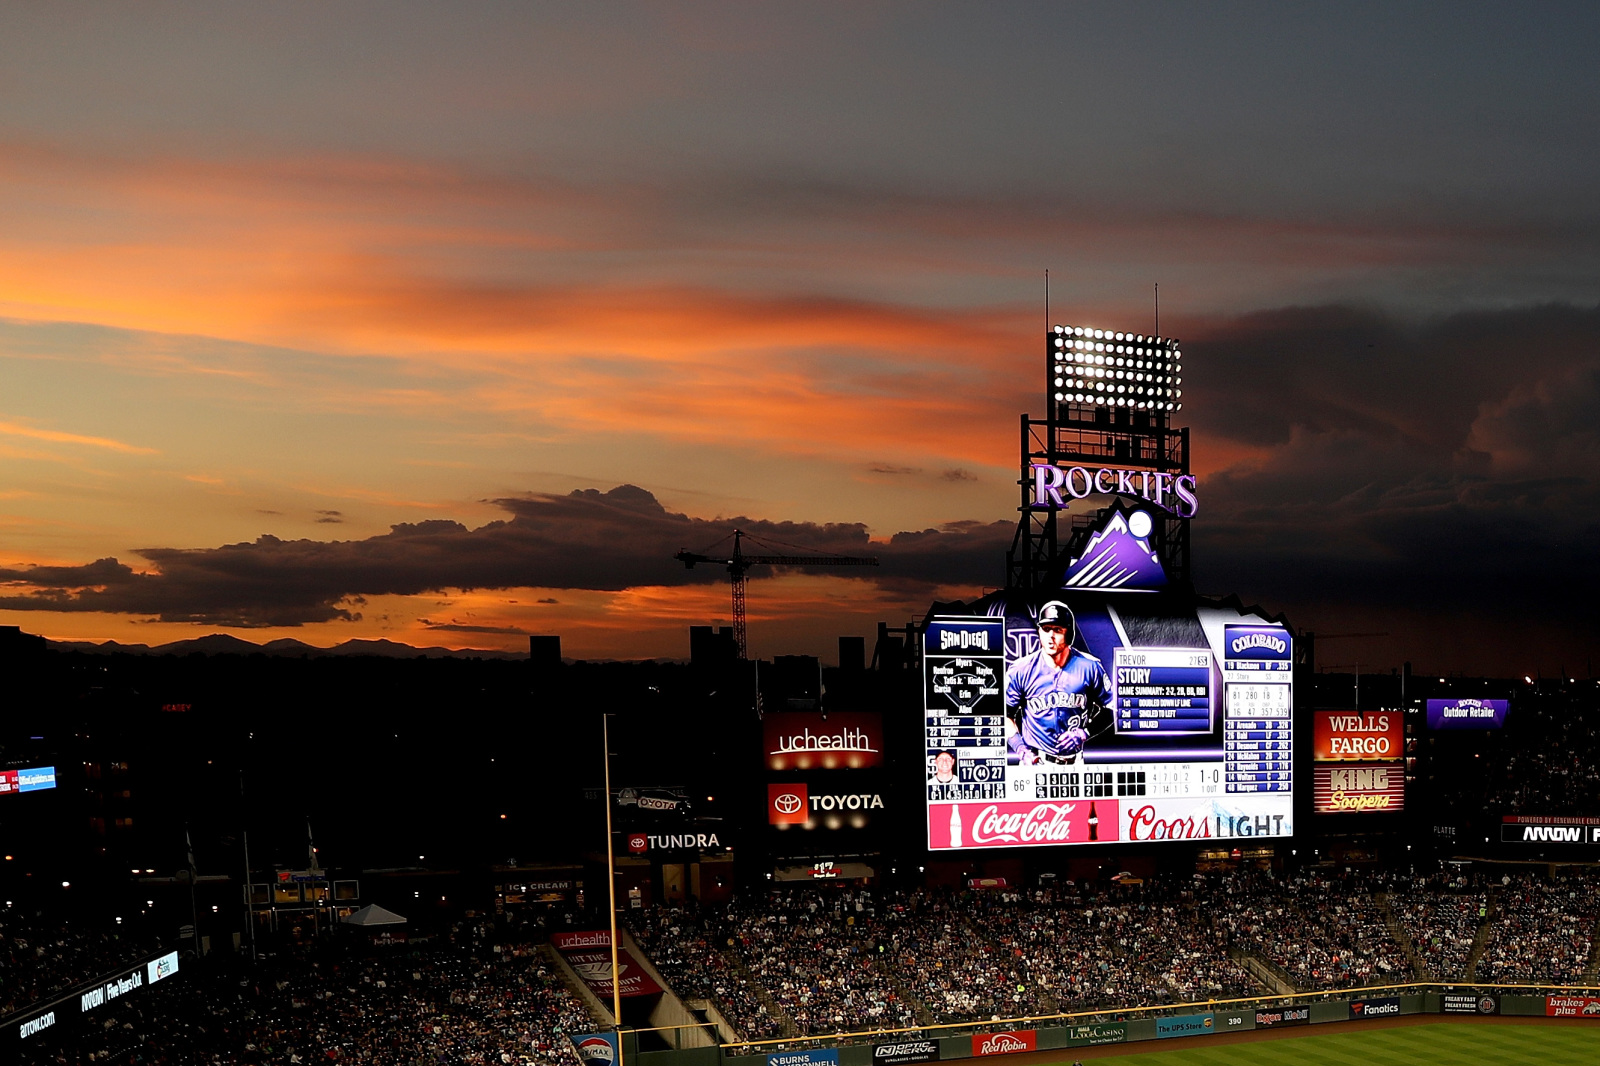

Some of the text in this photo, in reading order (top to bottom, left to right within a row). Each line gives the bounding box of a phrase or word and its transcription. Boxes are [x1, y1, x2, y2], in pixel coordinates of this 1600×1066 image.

[1030, 463, 1199, 518] ROCKIES
[941, 629, 988, 650] SAN DIEGO
[1232, 633, 1286, 654] COLORADO
[1119, 654, 1146, 665] TREVOR
[1118, 668, 1151, 684] STORY
[1118, 686, 1134, 695] GAME
[1443, 707, 1494, 718] Outdoor Retailer
[1329, 716, 1389, 732] WELLS
[779, 727, 869, 751] uchealth
[1330, 737, 1390, 754] FARGO
[962, 767, 972, 779] 17
[991, 767, 1002, 779] 27
[1330, 769, 1389, 790] KING
[810, 794, 884, 811] TOYOTA
[1329, 791, 1390, 813] Soopers
[971, 801, 1076, 844] Coca-Cola
[1127, 804, 1284, 842] Coors LIGHT
[1517, 816, 1543, 824] POWERED
[1544, 816, 1551, 824] BY
[1553, 817, 1585, 825] RENEWABLE
[647, 833, 720, 850] TUNDRA
[530, 882, 568, 890] CREAM
[561, 932, 611, 946] uchealth
[106, 970, 143, 1000] Five Years Out
[1364, 1003, 1399, 1015] Fanatics
[1550, 997, 1584, 1008] brakes
[1256, 1010, 1308, 1024] Exxon Mobil
[1555, 1007, 1577, 1016] plus
[20, 1011, 56, 1039] arrow.com
[1172, 1024, 1184, 1032] UPS
[1228, 1017, 1242, 1025] 390
[1093, 1026, 1124, 1038] CASINO
[895, 1046, 937, 1055] NERVE
[896, 1042, 930, 1050] OPTIC
[981, 1038, 1027, 1054] Red Robin
[779, 1055, 810, 1065] BURNS
